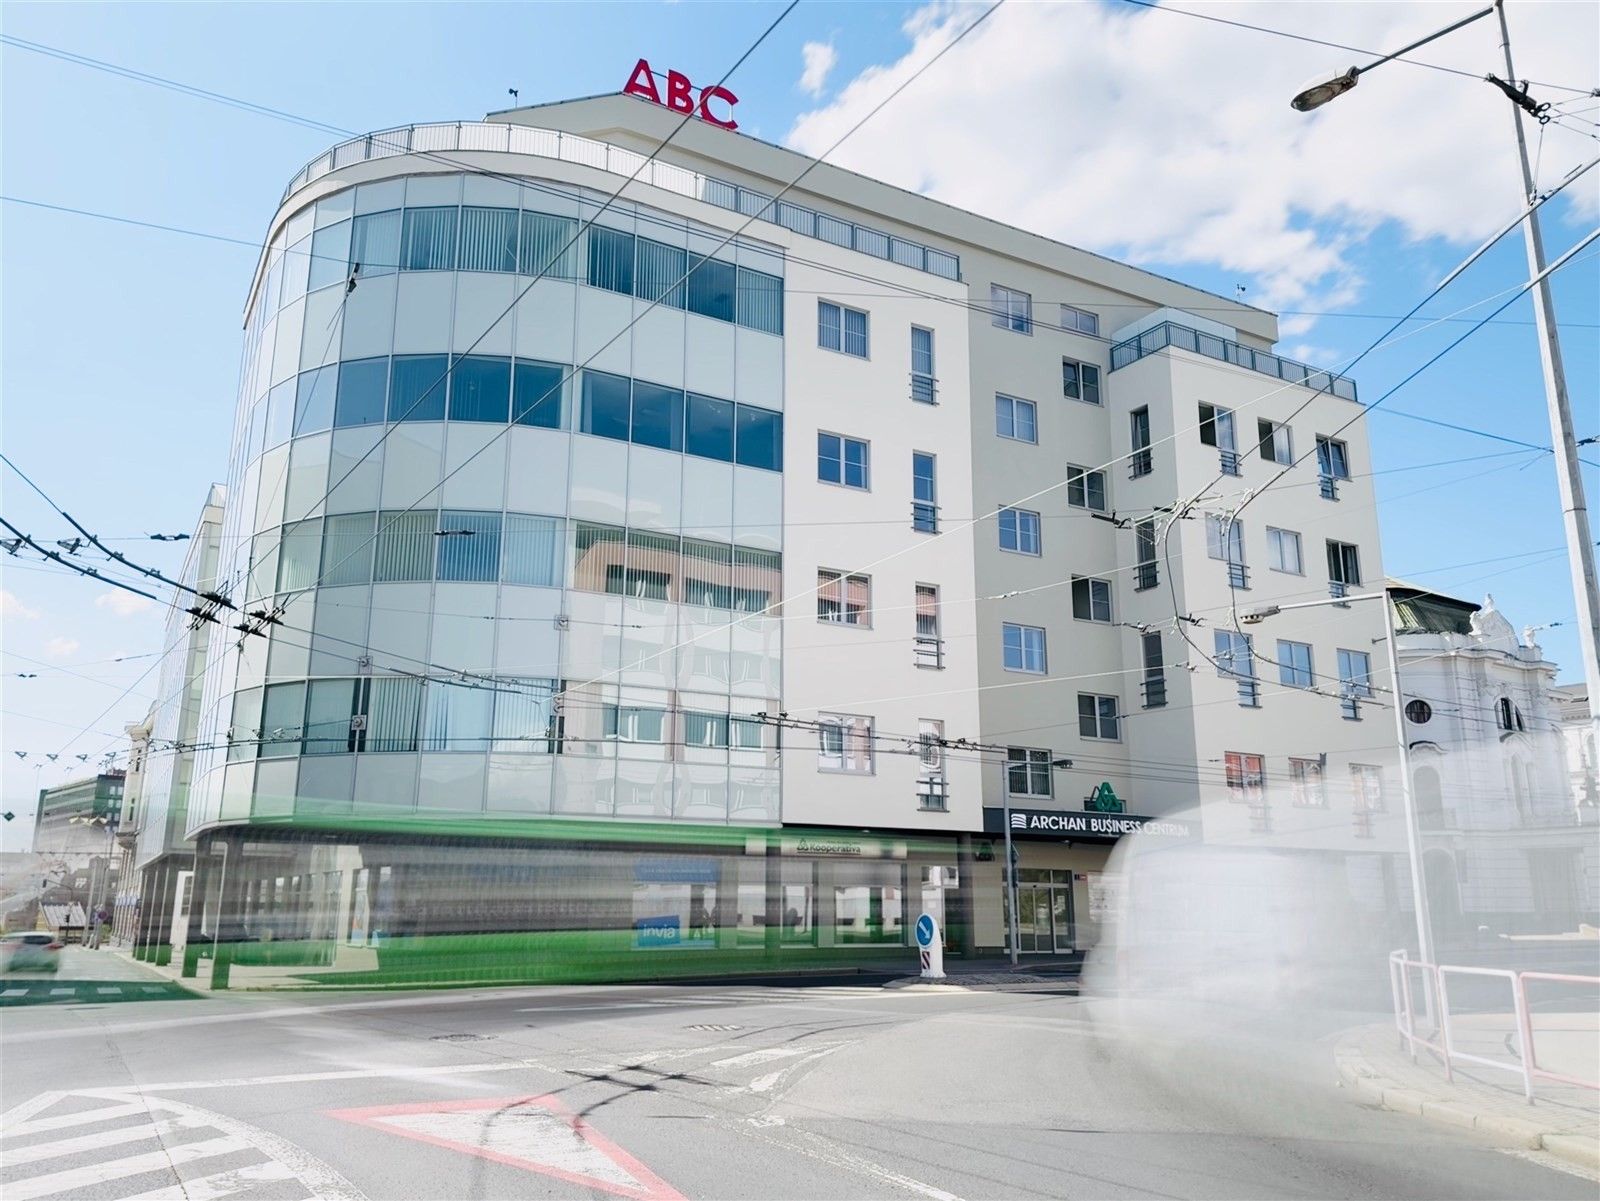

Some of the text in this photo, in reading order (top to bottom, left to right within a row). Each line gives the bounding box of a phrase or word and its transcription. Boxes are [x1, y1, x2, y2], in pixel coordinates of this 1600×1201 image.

[623, 58, 739, 131] ABC
[1030, 815, 1086, 831] ARCHAN
[1090, 818, 1141, 834] BUSINESS
[809, 842, 862, 854] Kooperativa
[643, 924, 676, 939] invia
